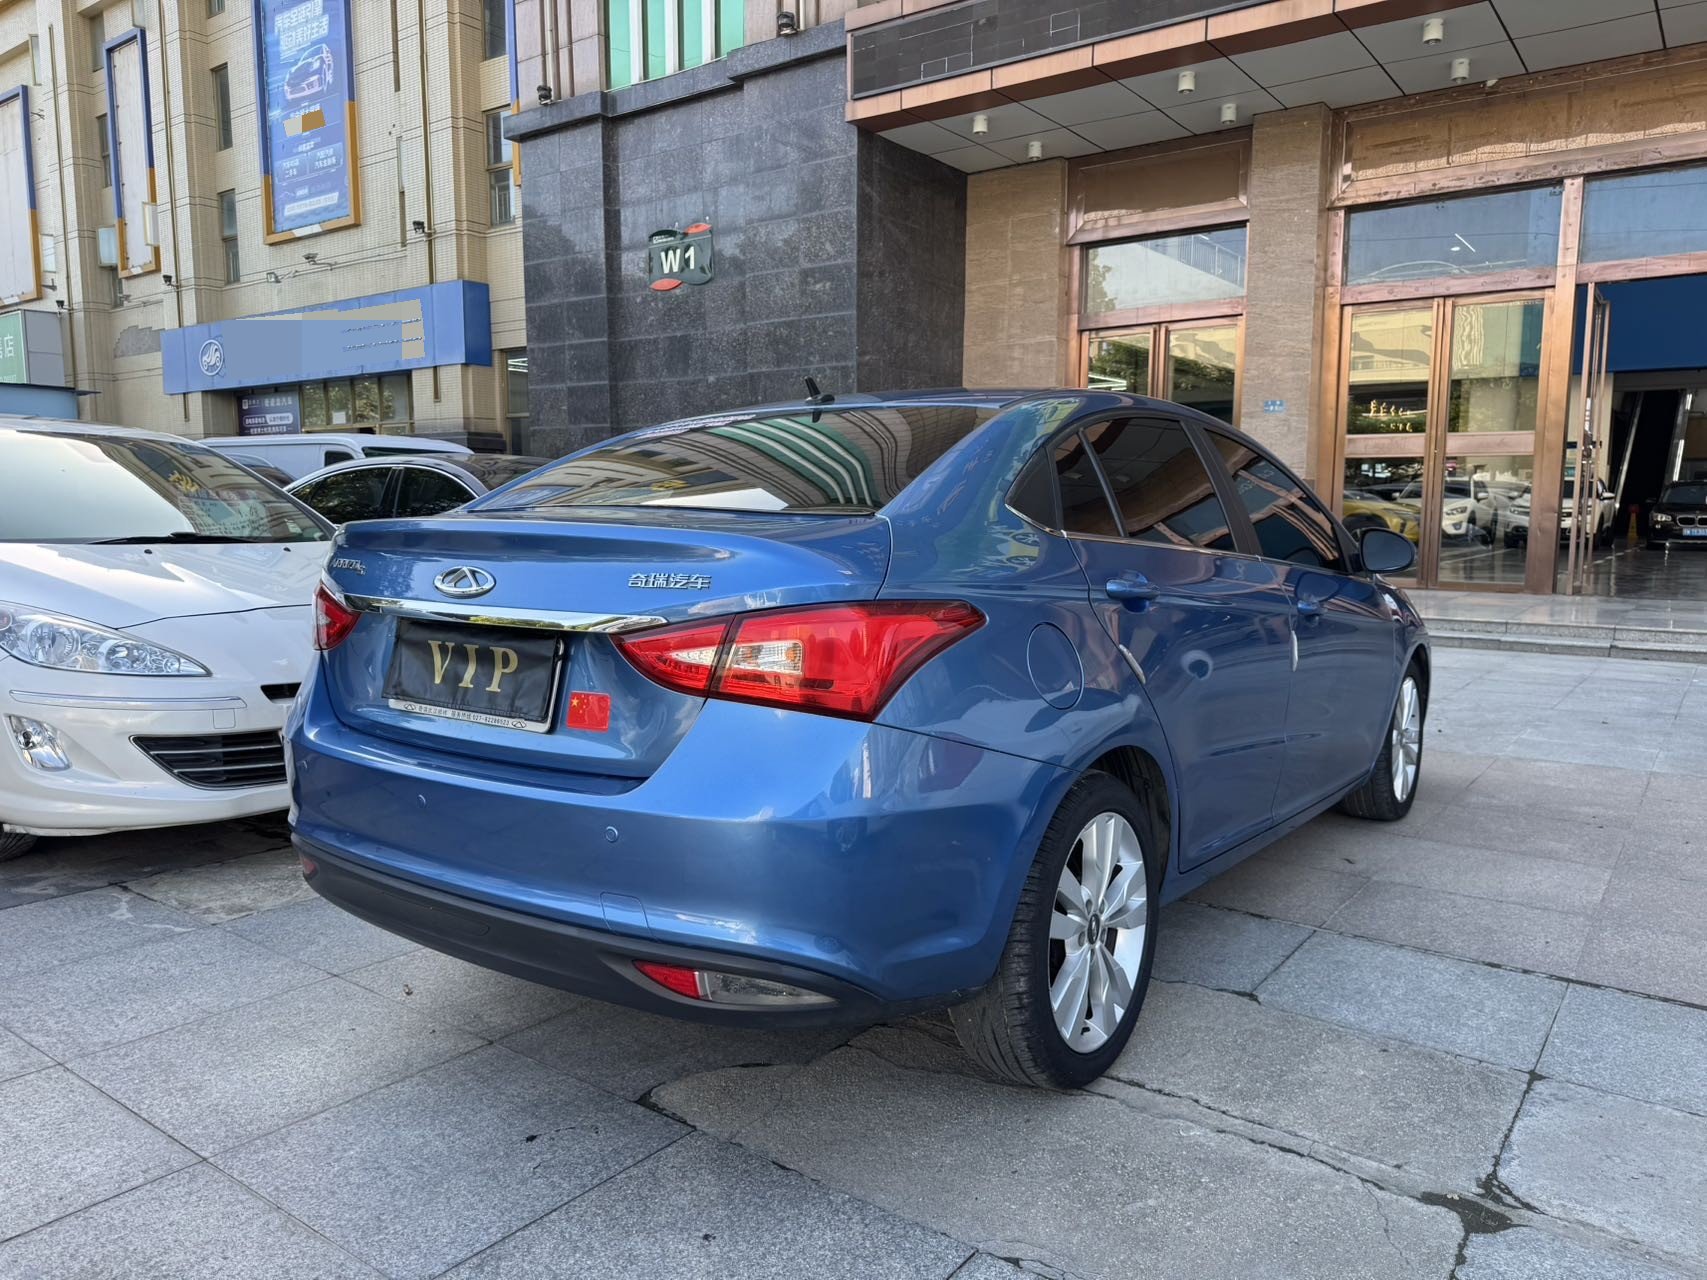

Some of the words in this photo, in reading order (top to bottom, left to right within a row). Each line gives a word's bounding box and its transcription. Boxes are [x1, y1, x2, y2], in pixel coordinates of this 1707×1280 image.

[660, 245, 695, 274] W1
[628, 572, 712, 590] 奇瑞汽车
[428, 640, 518, 692] VIP
